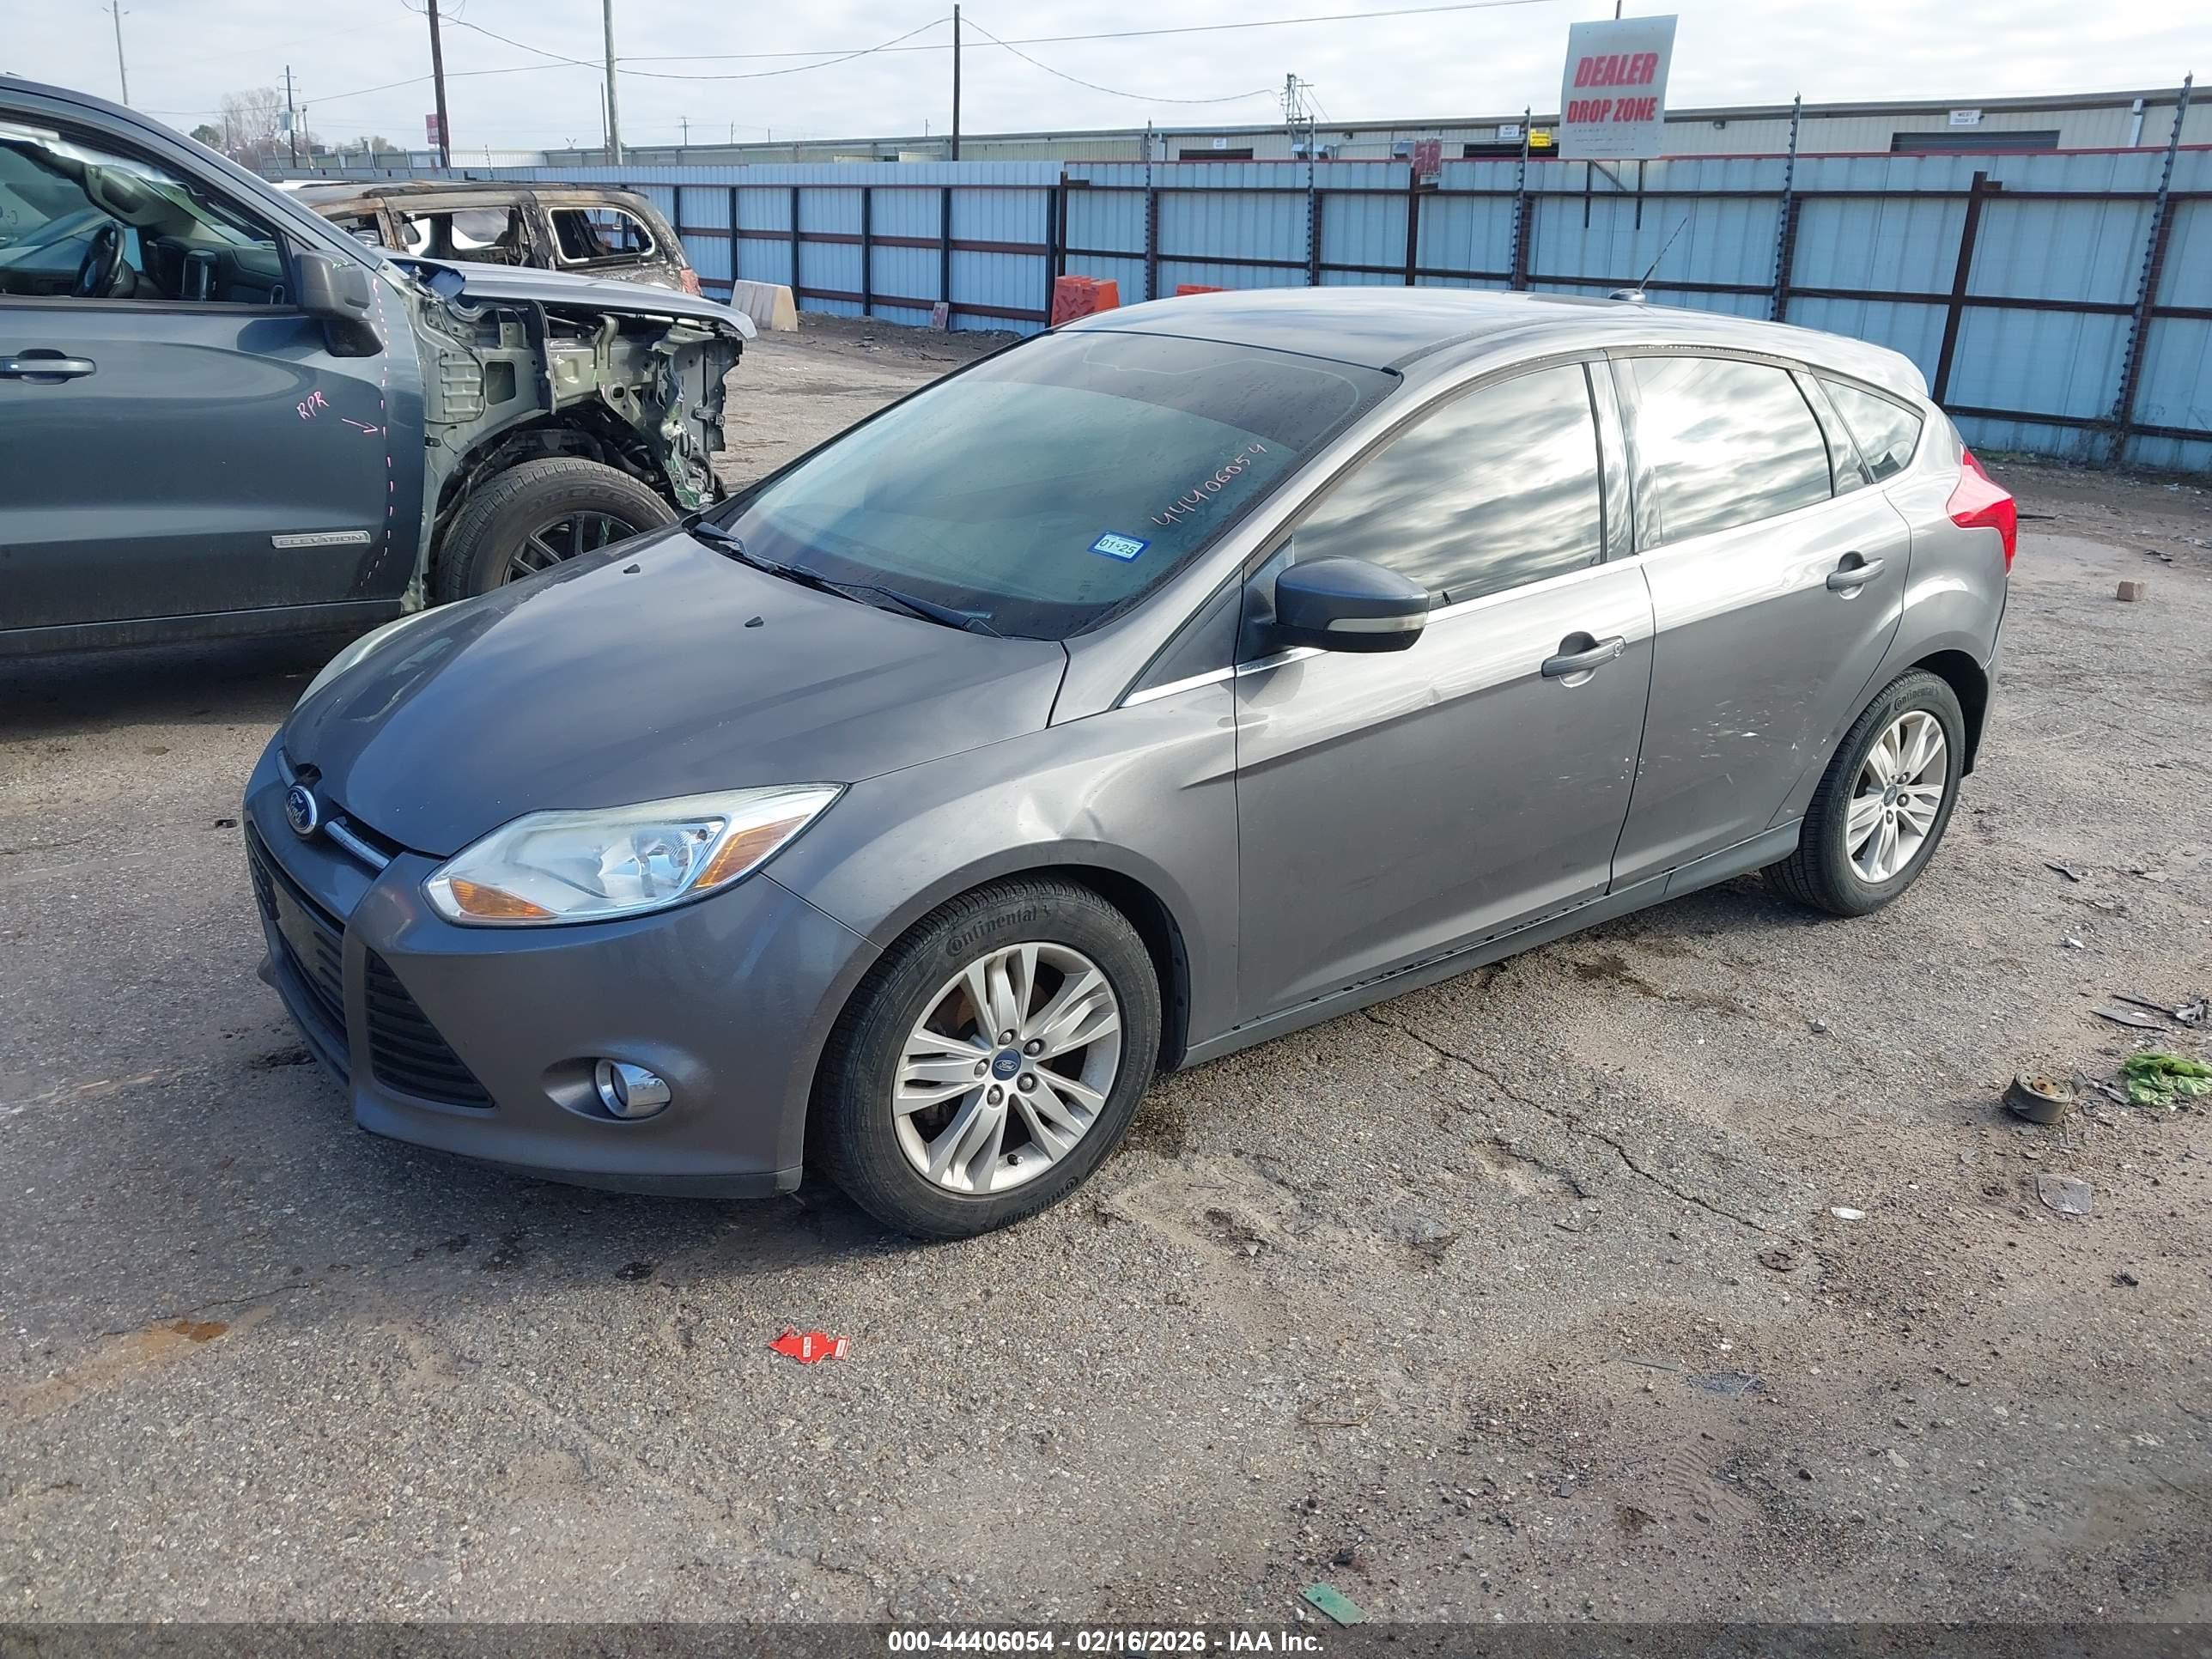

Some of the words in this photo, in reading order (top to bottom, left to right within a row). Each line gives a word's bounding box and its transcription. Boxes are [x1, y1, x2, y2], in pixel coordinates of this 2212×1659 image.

[1574, 52, 1659, 88] DEALER
[1566, 99, 1613, 124] DROP
[1613, 97, 1658, 123] ZONE
[296, 391, 330, 420] RPR
[1151, 443, 1267, 526] 44406054
[279, 534, 362, 545] ELEVATION
[945, 905, 1037, 957] Continental
